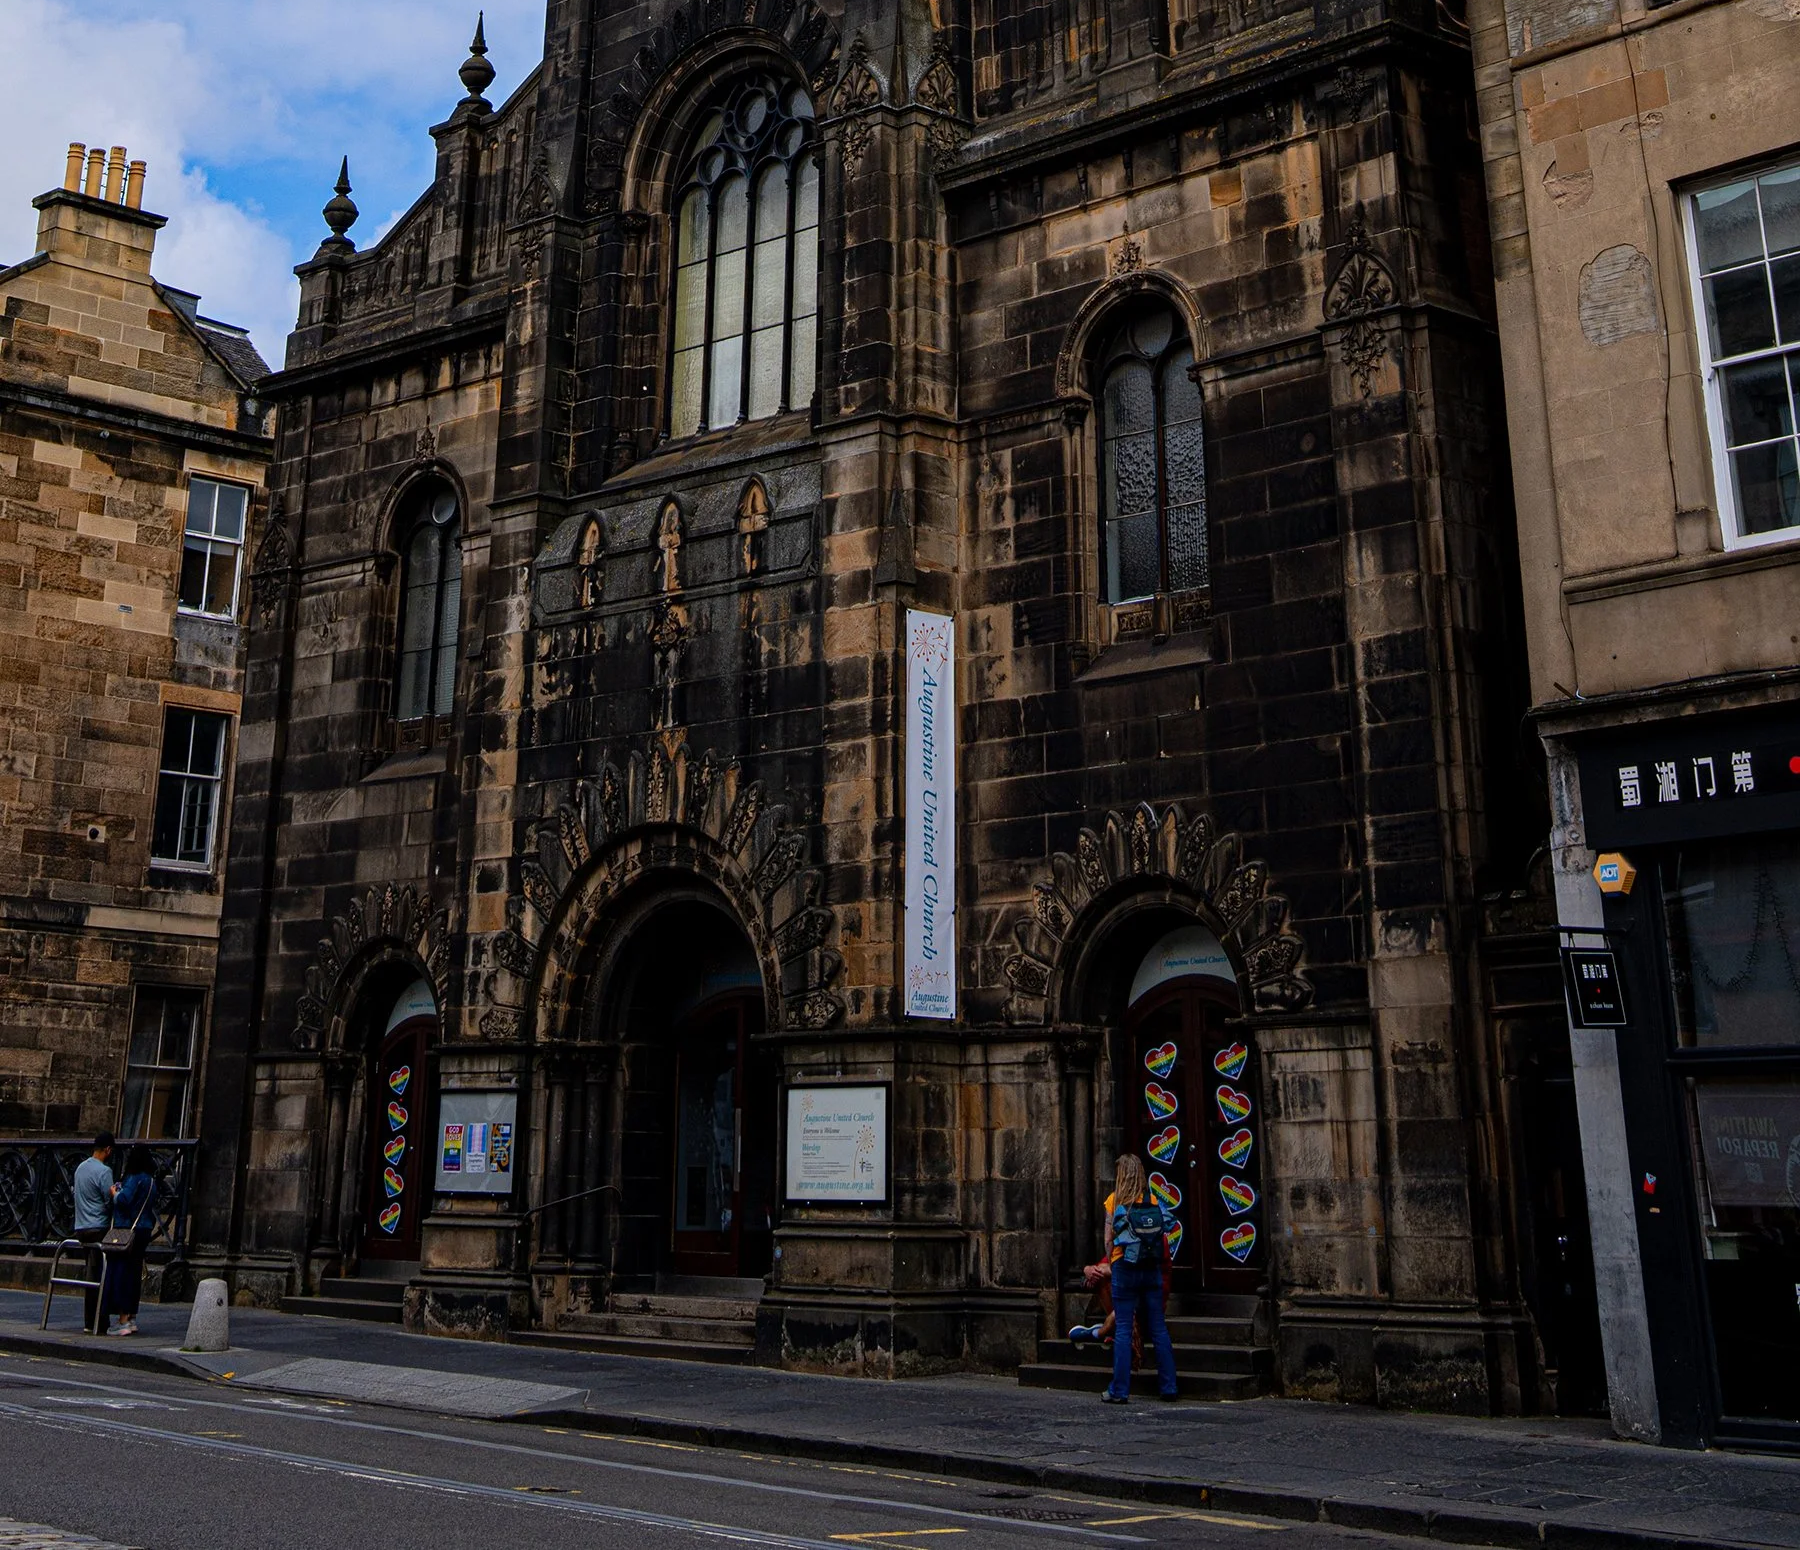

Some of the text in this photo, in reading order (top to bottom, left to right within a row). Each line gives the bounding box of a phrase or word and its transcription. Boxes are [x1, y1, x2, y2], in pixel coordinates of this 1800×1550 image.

[1618, 750, 1755, 808] 蜀湘门第
[917, 666, 939, 961] Augustine United Church
[1601, 866, 1618, 878] ADT
[911, 990, 950, 1005] Augustine
[911, 1003, 950, 1013] United Church
[853, 1111, 875, 1122] Church
[449, 1126, 460, 1134] GOD
[1232, 1231, 1244, 1240] GOD
